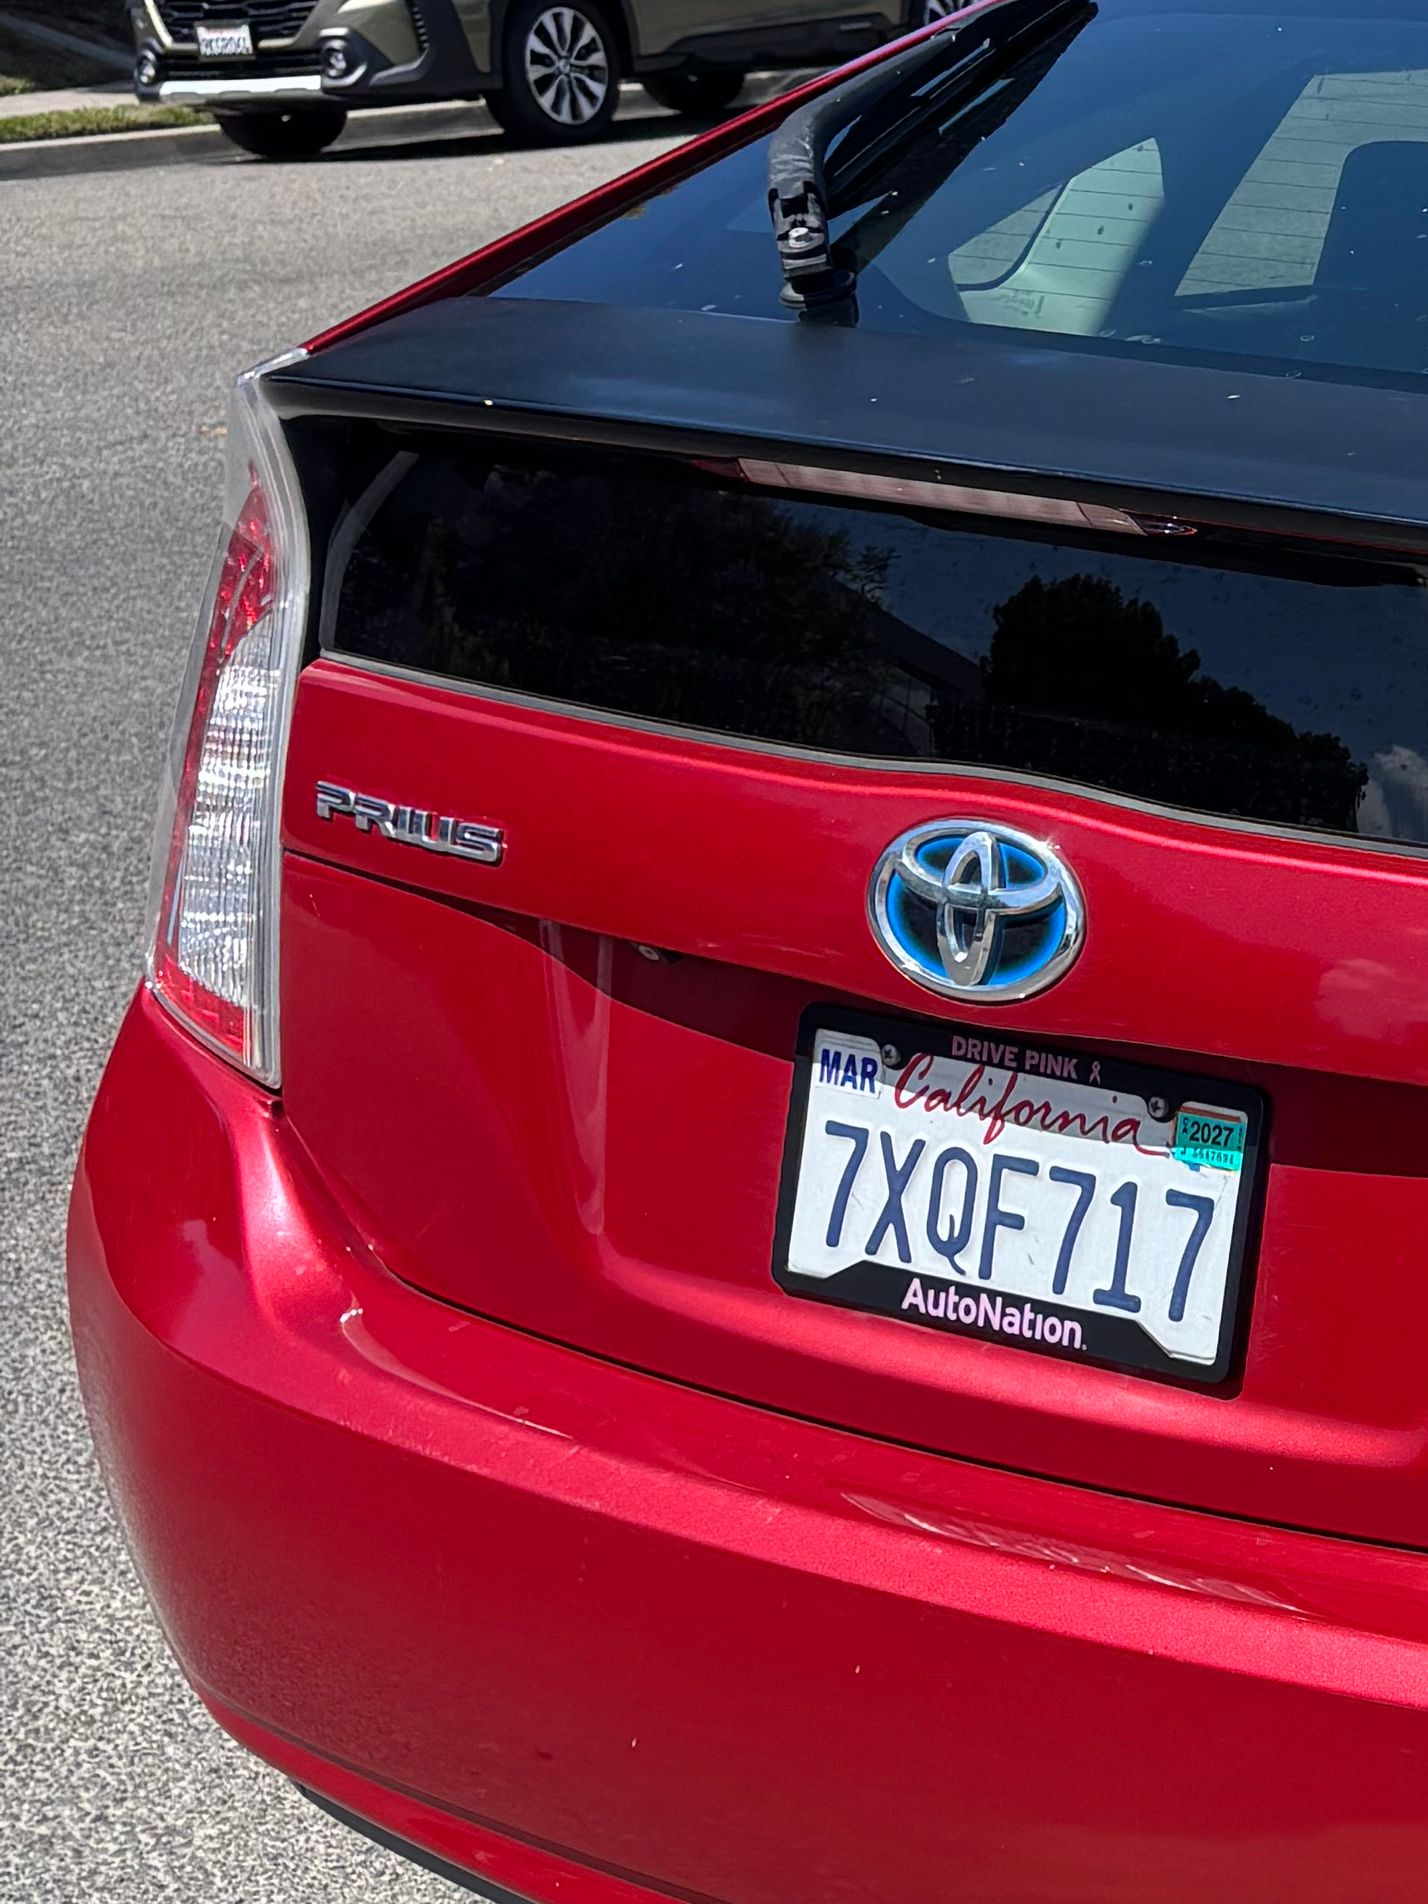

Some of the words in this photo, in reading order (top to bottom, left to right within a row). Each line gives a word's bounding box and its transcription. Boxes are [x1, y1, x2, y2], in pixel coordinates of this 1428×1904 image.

[316, 780, 501, 863] PRIUS
[819, 1047, 878, 1094] MAR
[951, 1034, 1020, 1070] DRIVE
[1024, 1048, 1079, 1081] PINK
[893, 1051, 1171, 1159] California
[1188, 1120, 1235, 1148] 2027
[824, 1119, 1215, 1323] 7XQF717
[902, 1277, 1083, 1350] AutoNation
